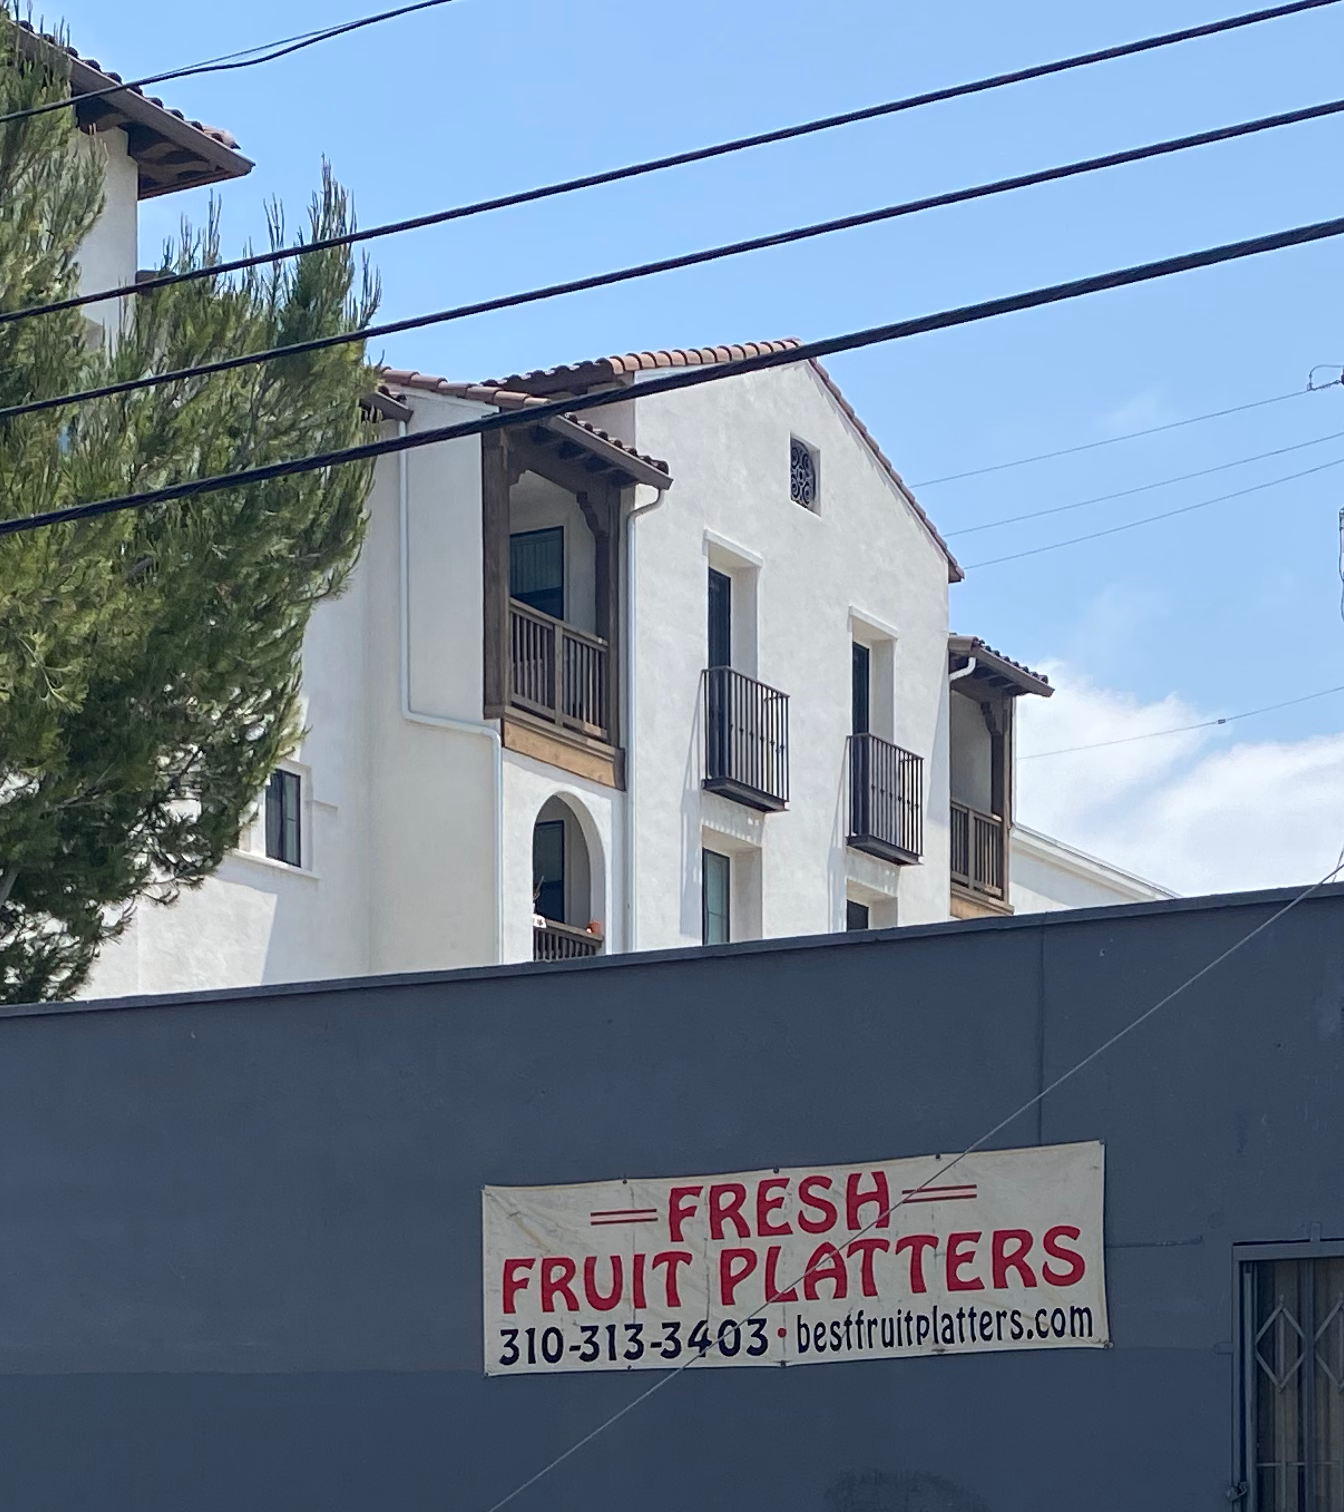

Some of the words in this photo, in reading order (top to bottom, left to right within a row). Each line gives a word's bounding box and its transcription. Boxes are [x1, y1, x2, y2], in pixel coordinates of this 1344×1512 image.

[668, 1171, 890, 1242] FRESH
[502, 1251, 693, 1314] FRUIT
[720, 1225, 1086, 1306] PLATTERS
[499, 1318, 769, 1366] 310-313-3403
[797, 1305, 1093, 1353] bestfruitplatters.com
